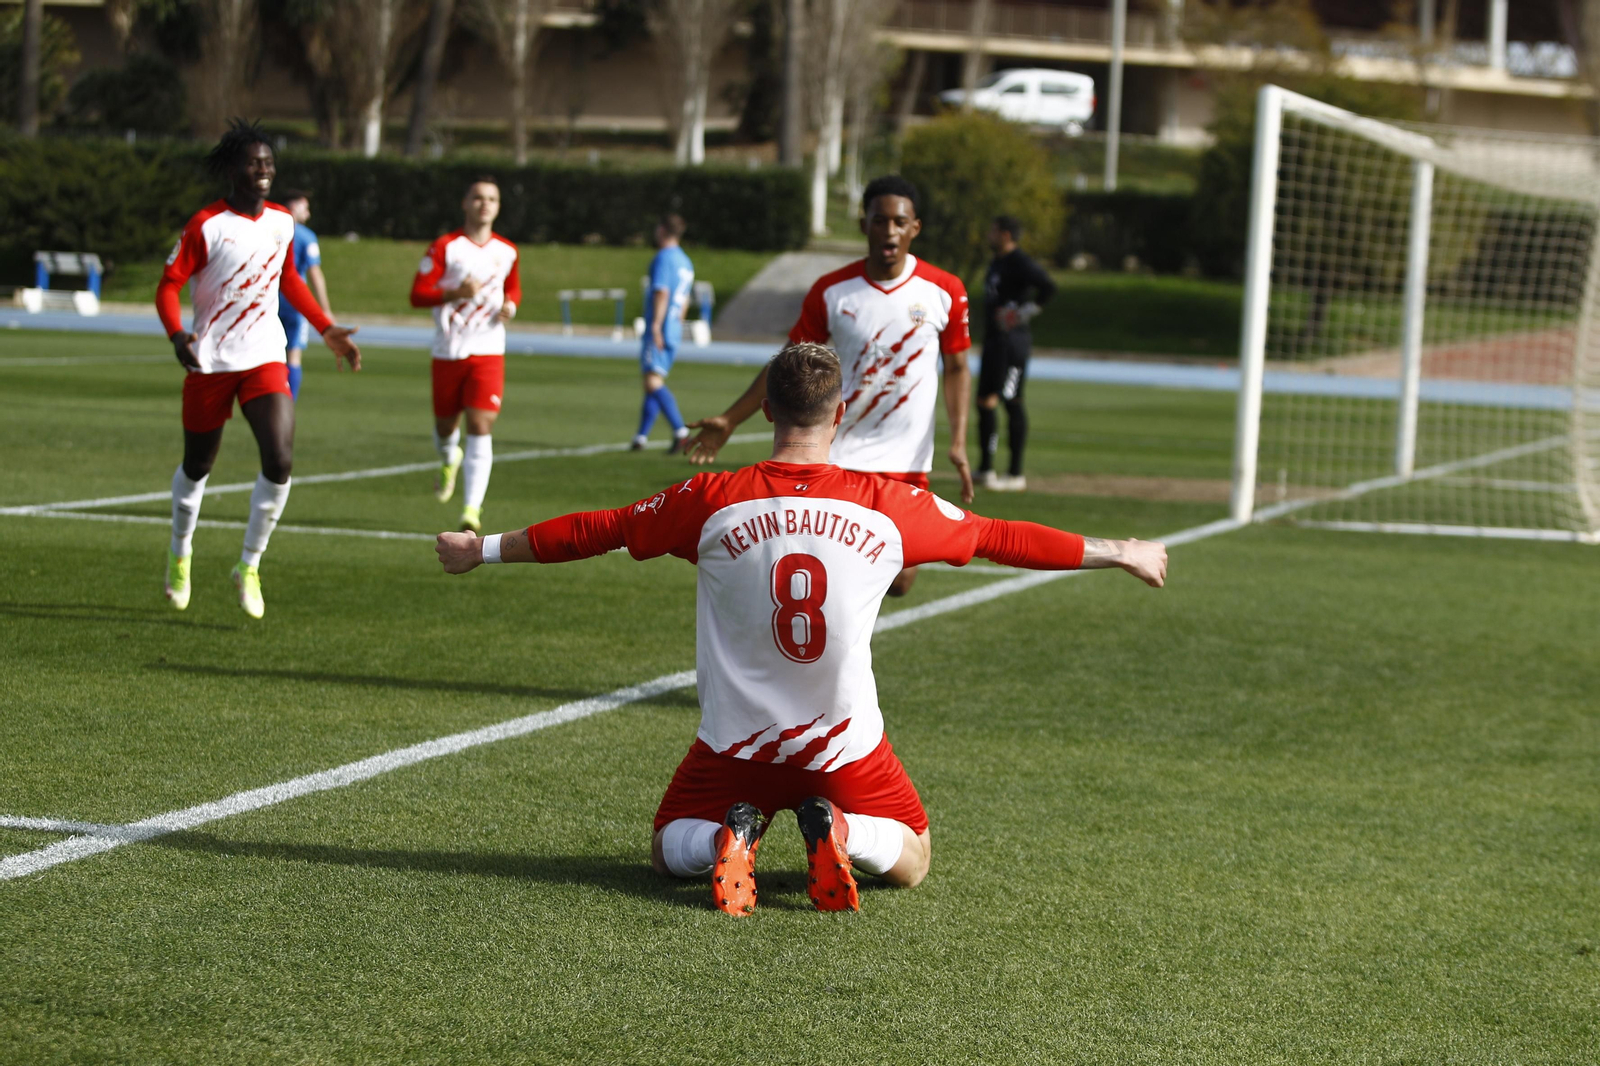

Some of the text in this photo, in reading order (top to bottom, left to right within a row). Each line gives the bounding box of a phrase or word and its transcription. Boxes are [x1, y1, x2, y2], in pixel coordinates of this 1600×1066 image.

[720, 509, 887, 565] KEVIN BAUTISTA
[770, 553, 828, 664] 8
